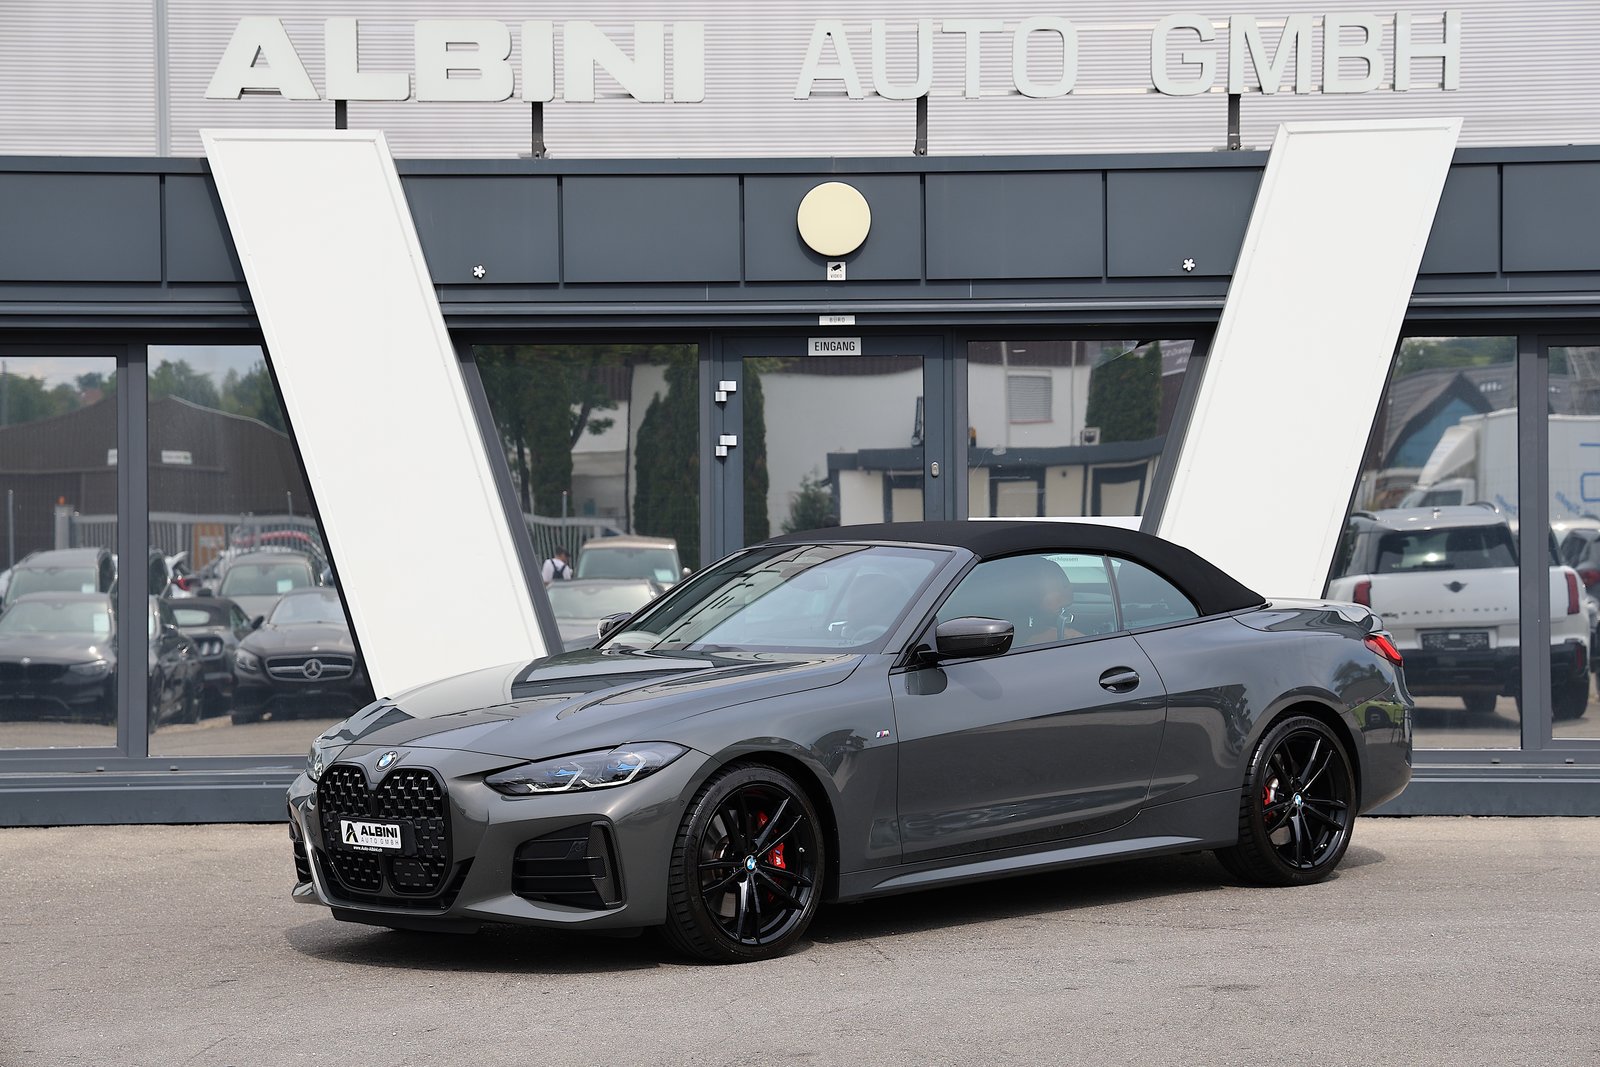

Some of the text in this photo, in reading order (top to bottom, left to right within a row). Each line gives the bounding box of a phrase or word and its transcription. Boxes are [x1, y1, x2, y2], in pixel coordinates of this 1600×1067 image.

[204, 10, 1462, 103] ALBINI AUTO GMBH
[814, 341, 855, 351] EINGANG
[361, 825, 398, 838] ALBINI
[380, 838, 399, 846] GMBH
